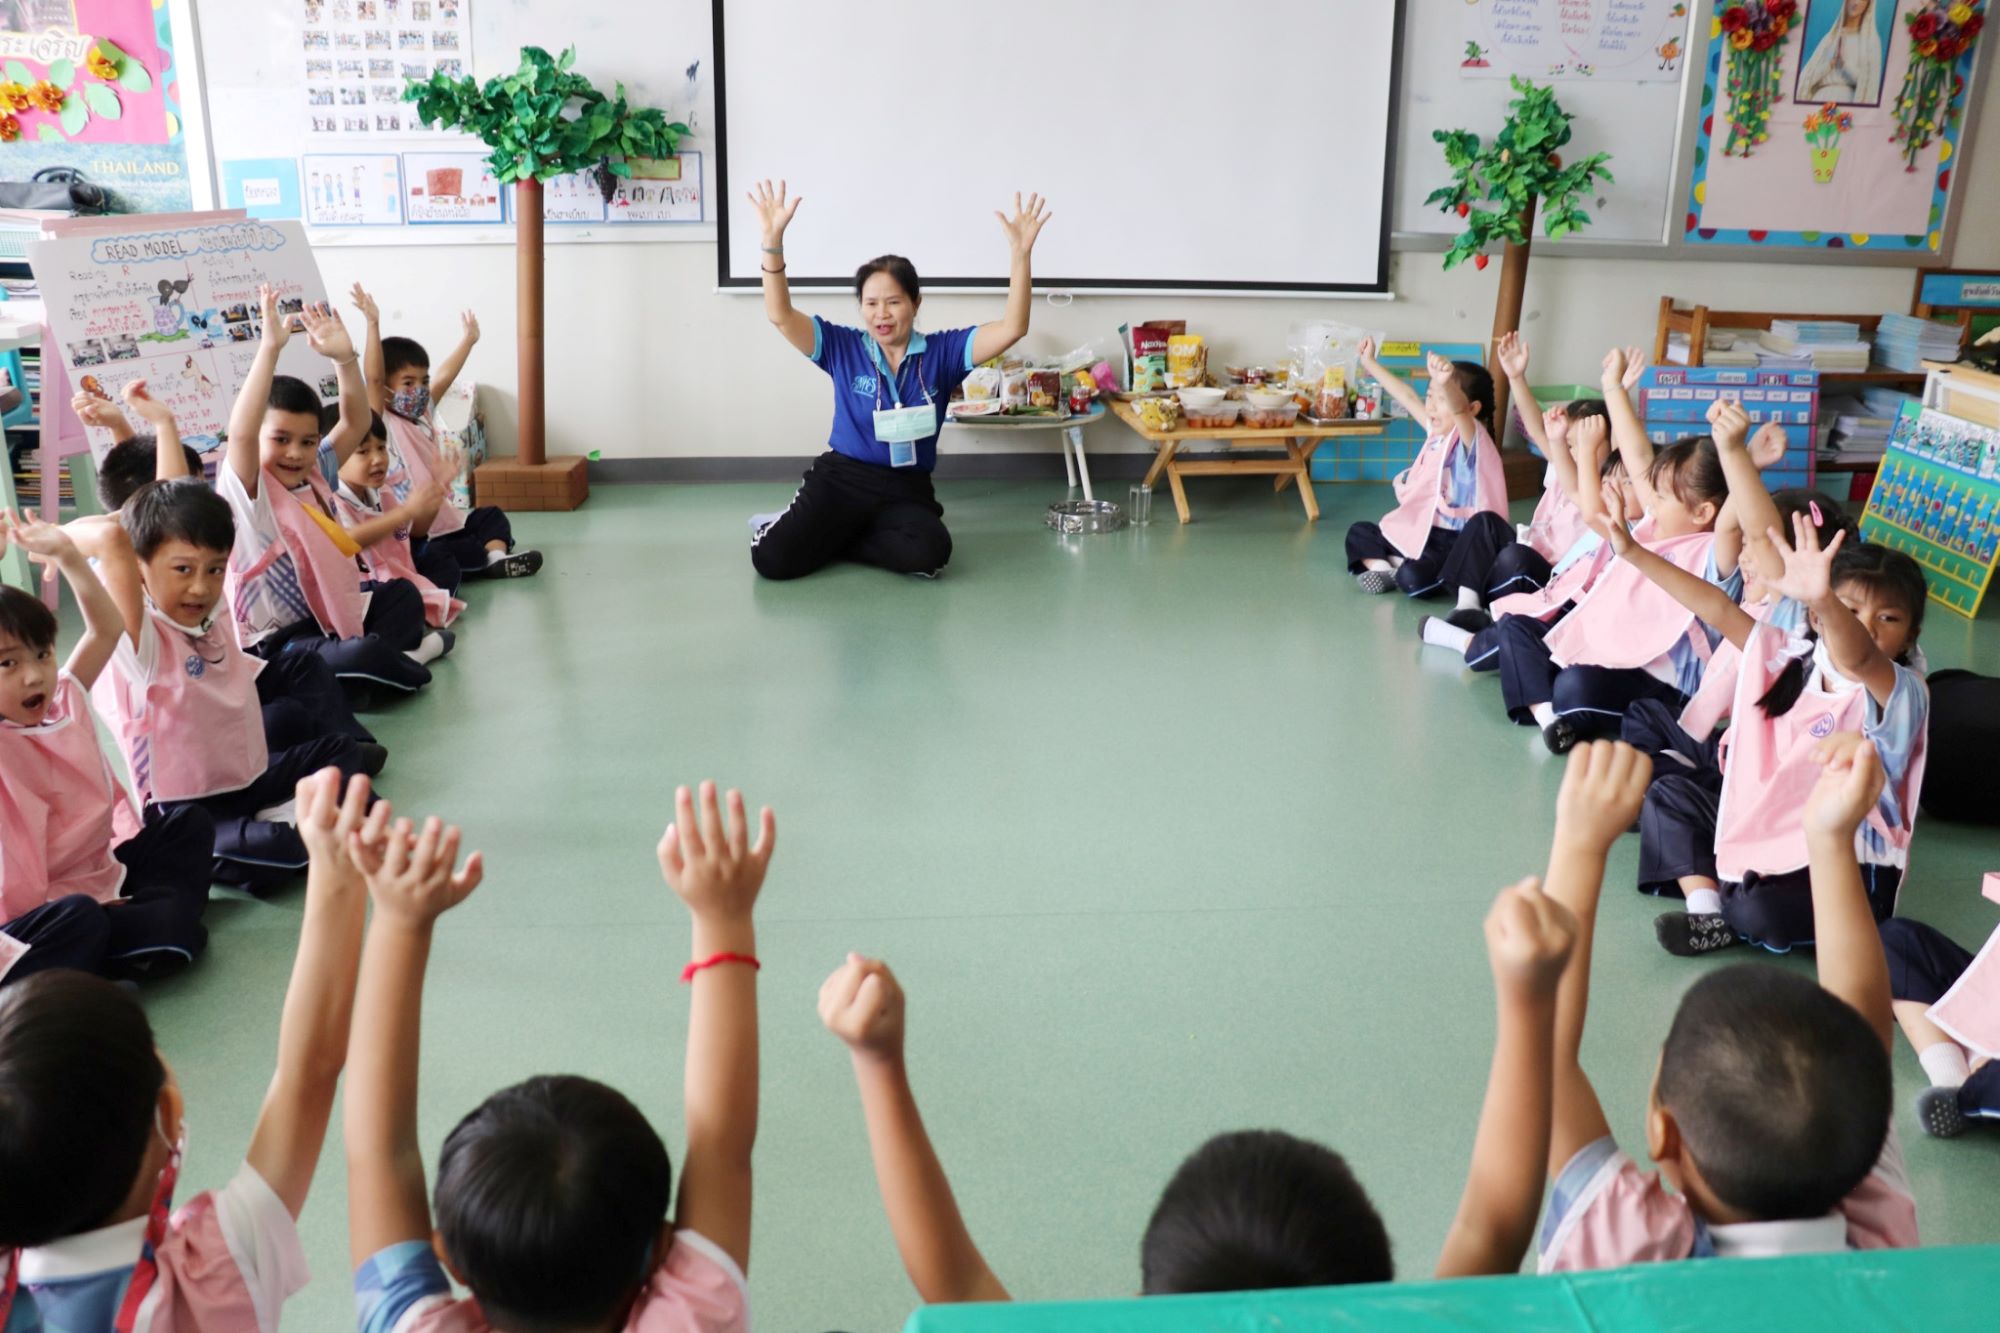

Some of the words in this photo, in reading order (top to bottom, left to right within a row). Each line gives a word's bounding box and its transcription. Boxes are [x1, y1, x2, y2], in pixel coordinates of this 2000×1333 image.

[91, 160, 180, 175] THAILAND
[105, 244, 138, 260] READ
[144, 239, 188, 256] MODEL
